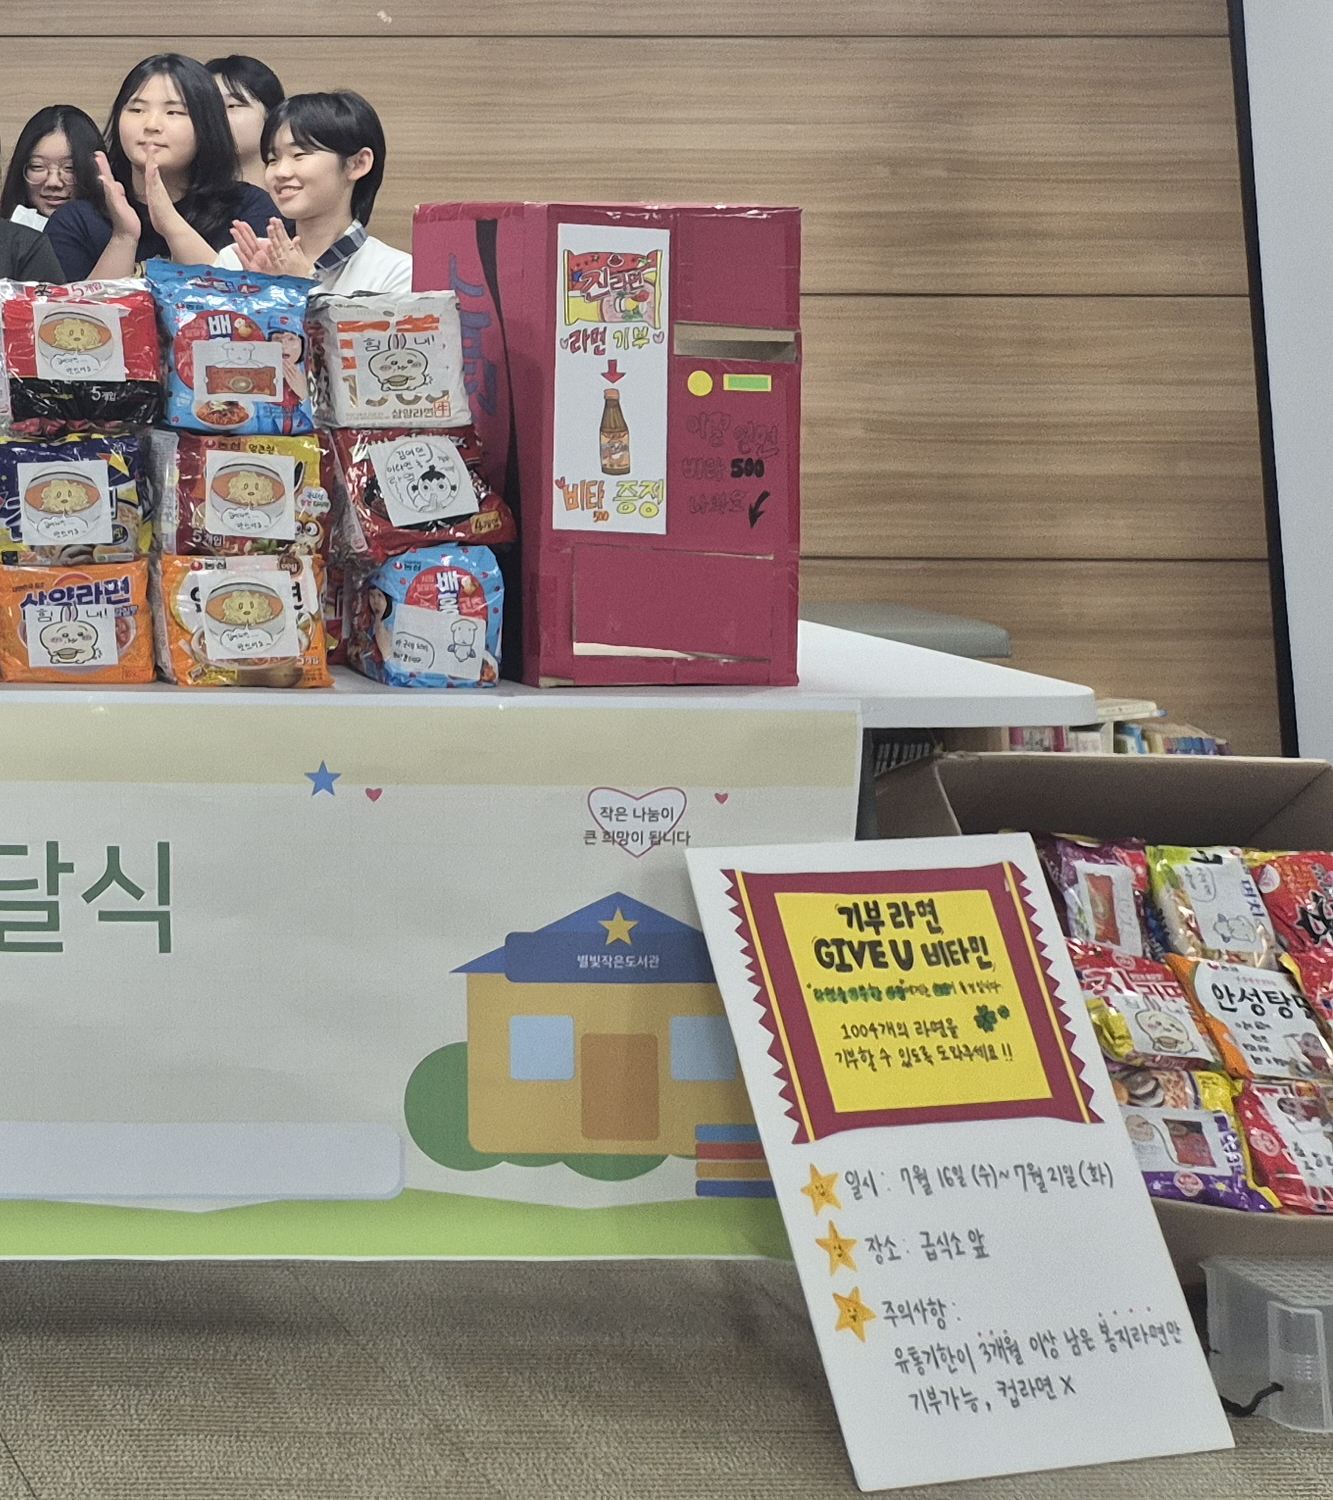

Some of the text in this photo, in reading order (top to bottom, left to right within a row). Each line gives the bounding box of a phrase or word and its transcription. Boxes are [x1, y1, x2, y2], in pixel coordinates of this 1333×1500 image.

[569, 326, 650, 356] 라면 기부
[730, 457, 765, 478] 500
[563, 479, 665, 518] 비타 증정
[593, 511, 610, 522] 500
[35, 608, 53, 622] 힘
[599, 805, 675, 822] 작은 나눔이
[583, 830, 691, 847] 큰 희망이 됩니다
[836, 899, 940, 934] 기부 라면
[576, 954, 661, 970] 별빛작은도서관
[813, 935, 993, 972] GIVE U 비타민
[835, 1046, 877, 1072] 기부할
[880, 1047, 892, 1067] 수
[919, 1228, 990, 1262] 급식소 앞
[894, 1319, 1183, 1375] 유통기한이 3개월 이상 남은 봉지라면만
[996, 1374, 1055, 1409] 컵라면
